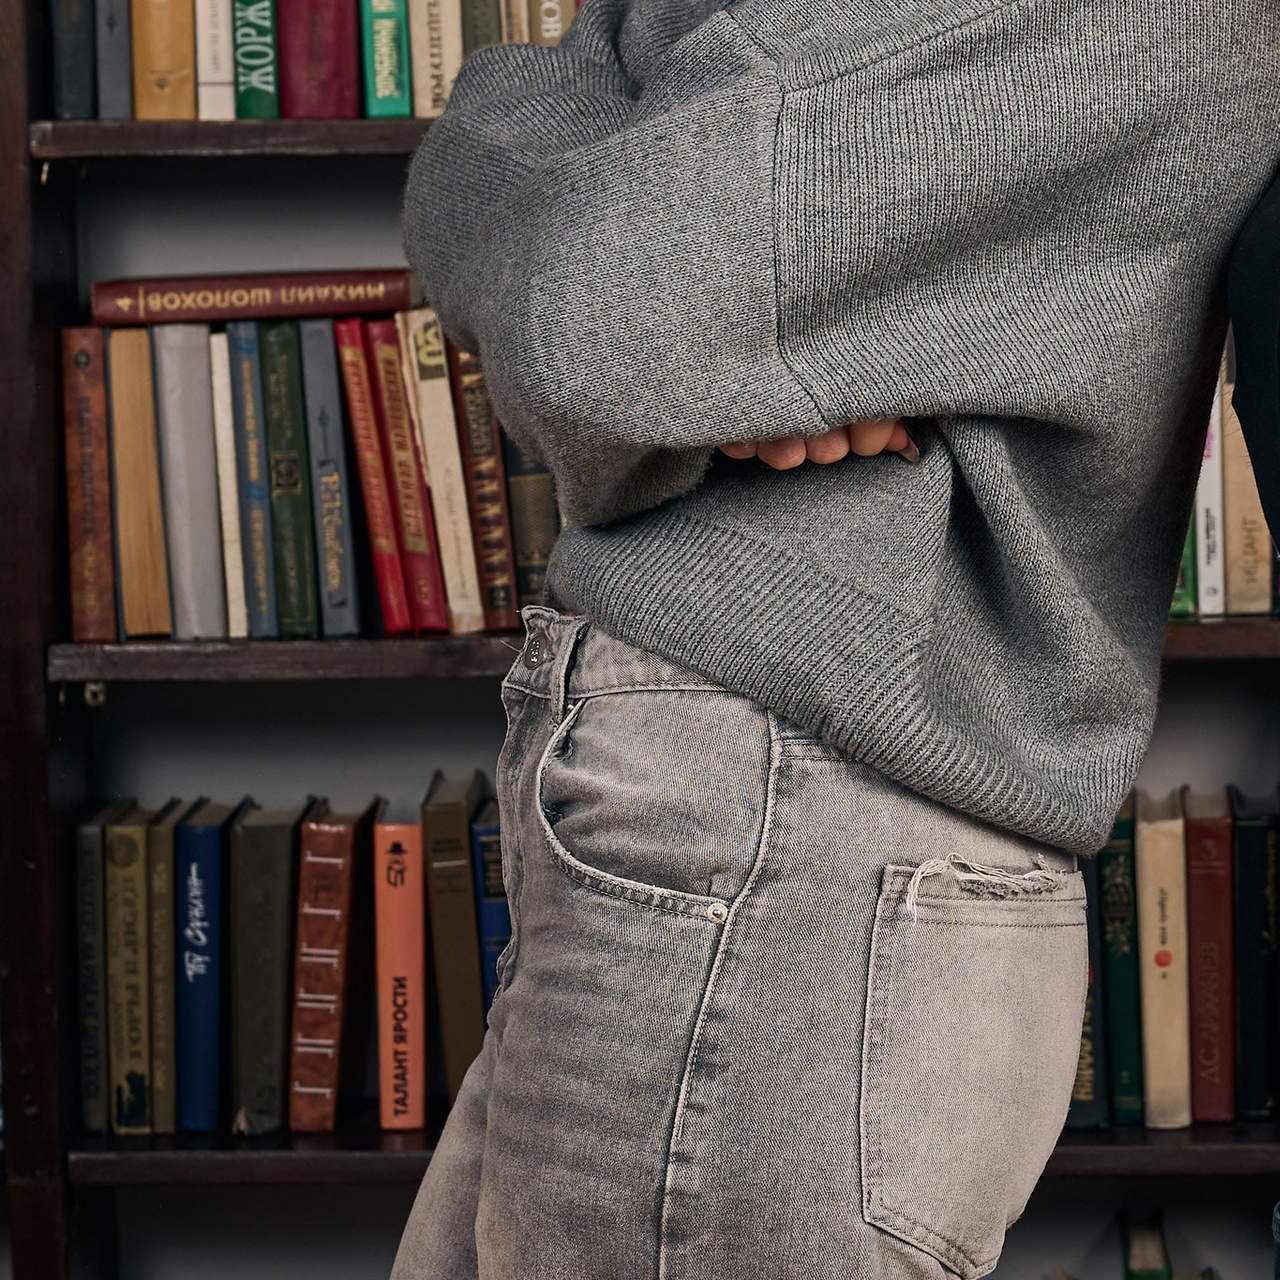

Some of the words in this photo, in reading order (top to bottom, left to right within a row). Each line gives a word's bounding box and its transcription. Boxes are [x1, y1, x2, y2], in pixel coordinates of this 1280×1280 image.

[235, 0, 276, 95] ЖОРЖ
[146, 287, 271, 310] ШОЛОХОВ
[280, 281, 385, 303] МИХАИЛ
[392, 976, 409, 1044] ЯРОСТИ
[392, 1049, 409, 1117] ТАЛАНТ
